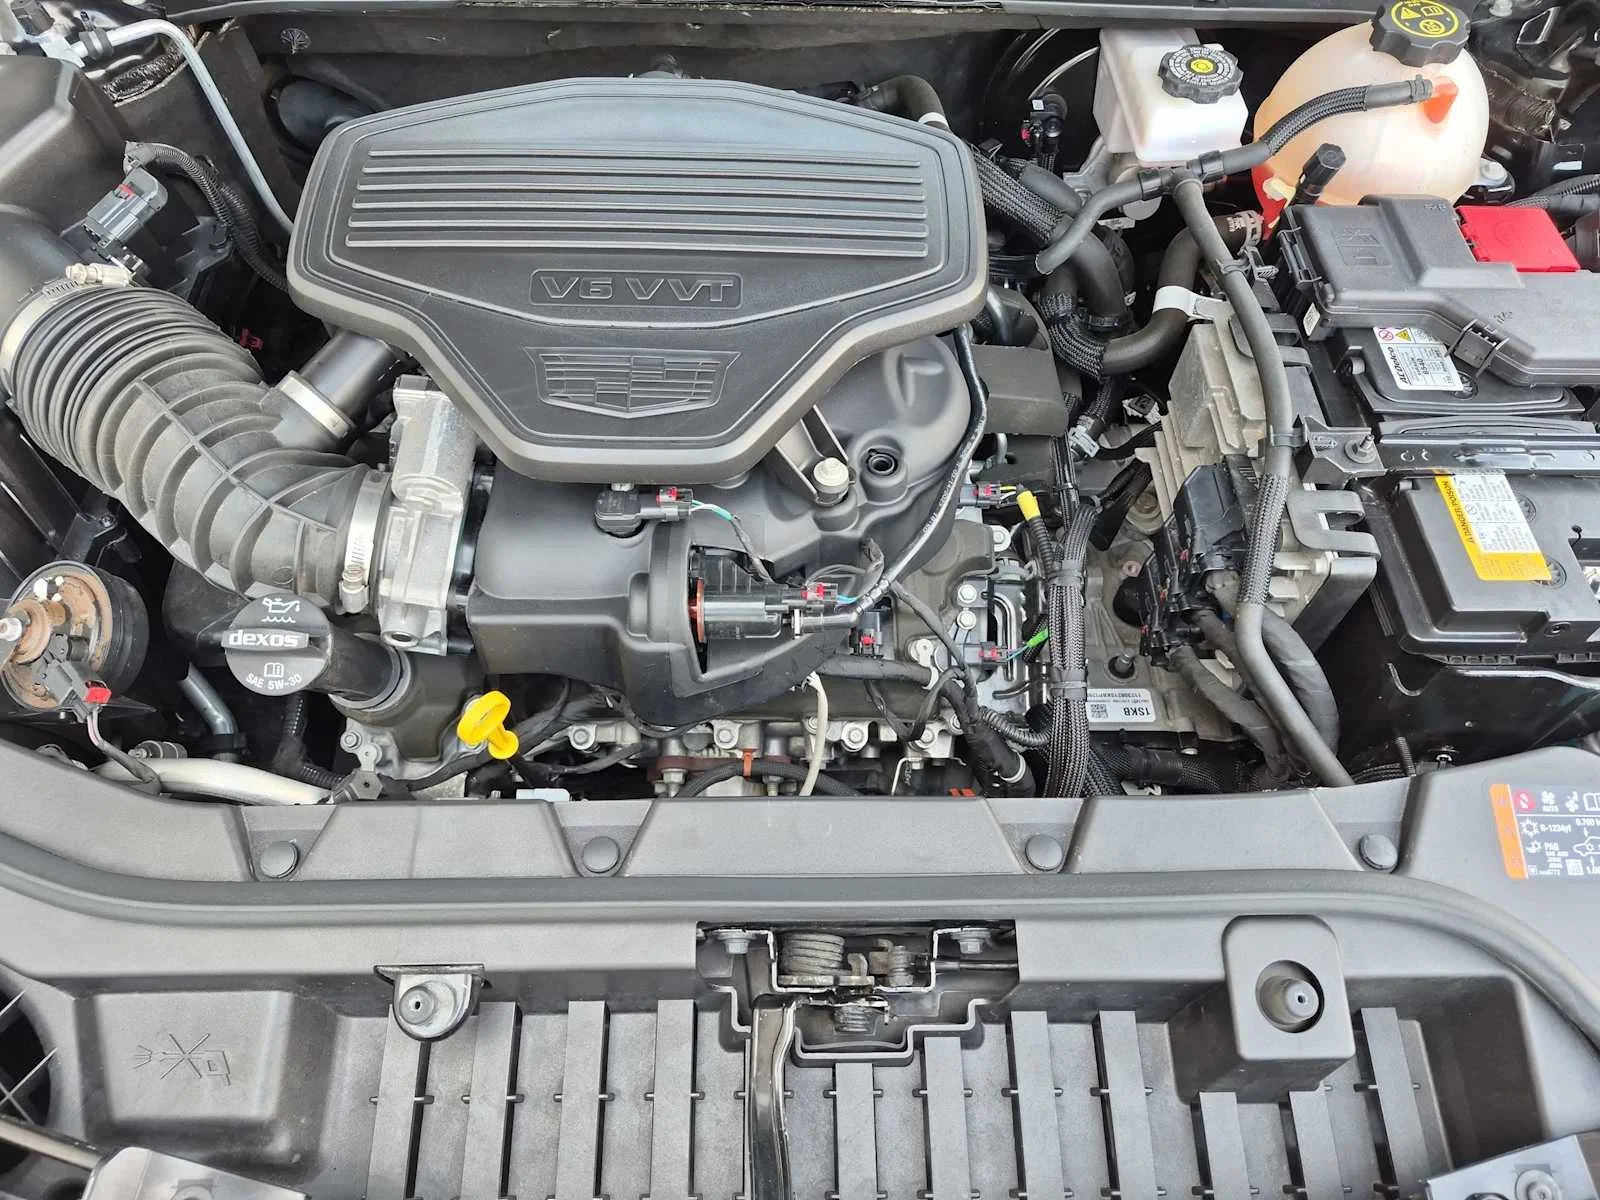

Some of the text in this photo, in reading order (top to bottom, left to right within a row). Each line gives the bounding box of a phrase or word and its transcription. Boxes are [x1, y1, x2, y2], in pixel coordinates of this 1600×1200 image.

[540, 276, 734, 302] V6 VVT
[1387, 346, 1408, 385] ACDelco
[228, 629, 299, 648] dexos
[245, 672, 302, 690] SAE 5W-30
[1123, 706, 1151, 717] 1SKB
